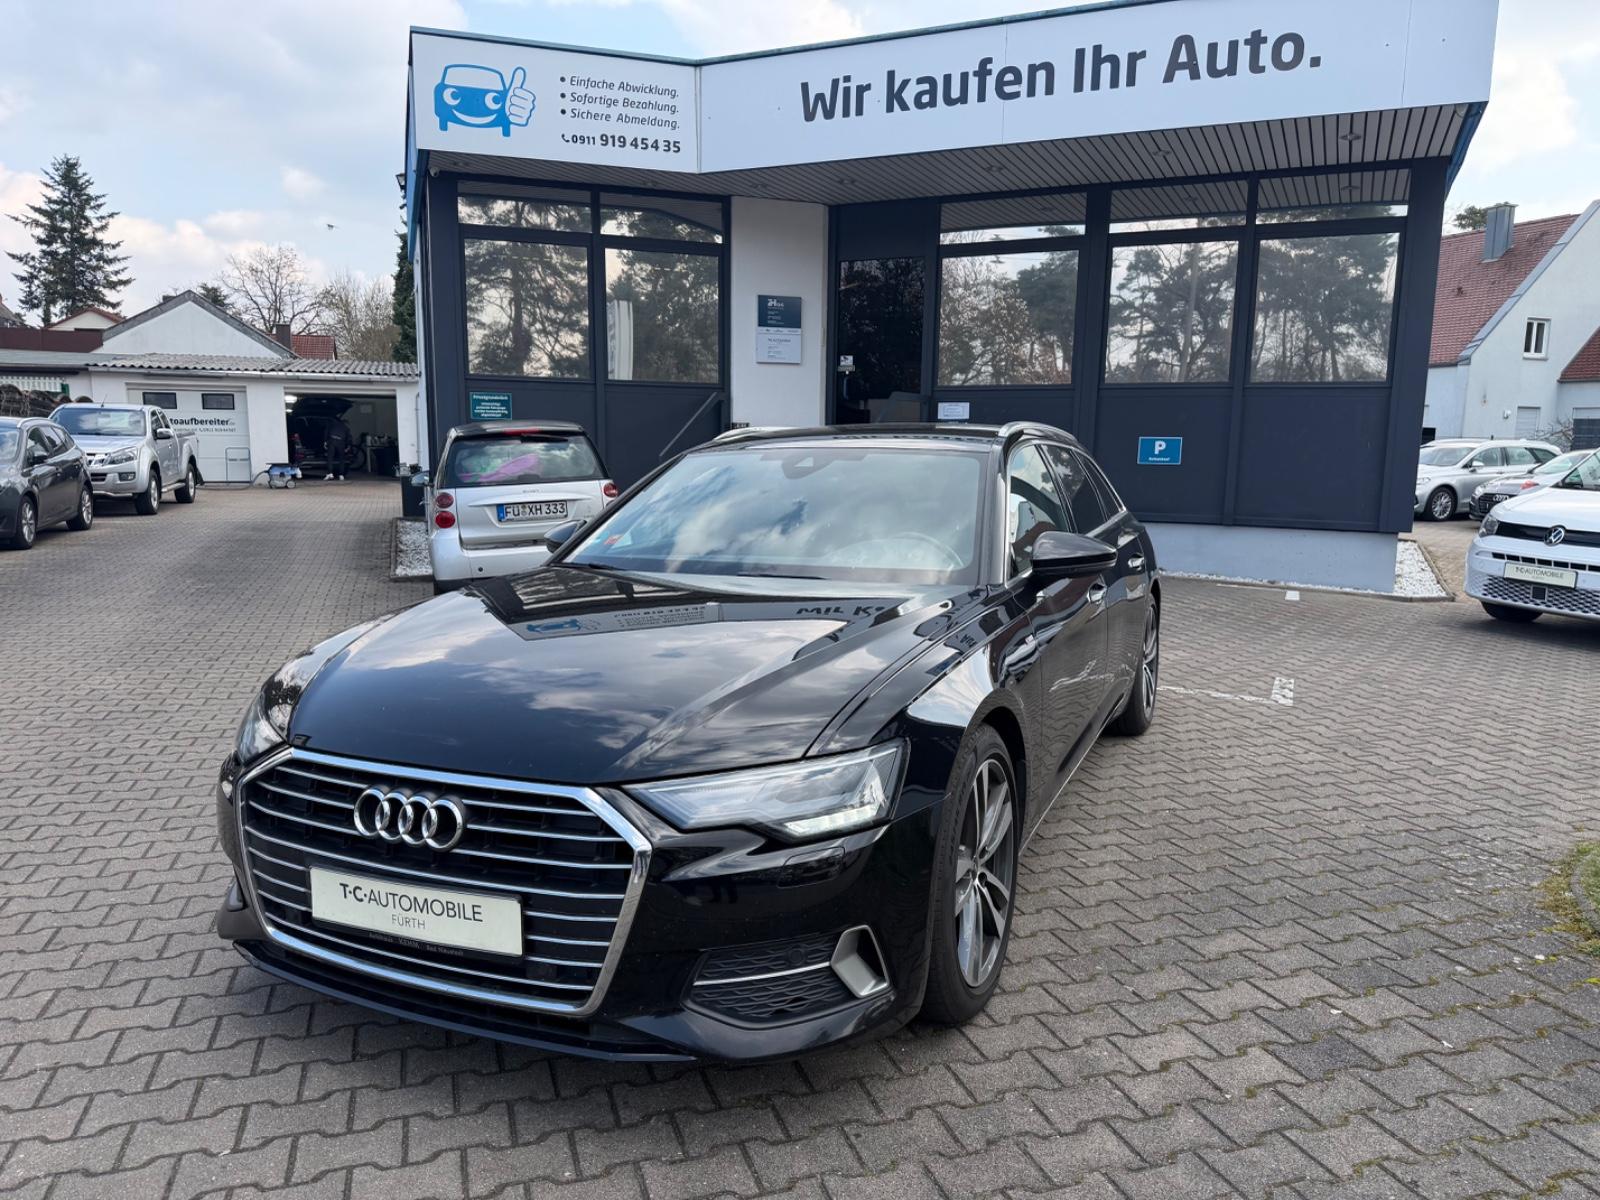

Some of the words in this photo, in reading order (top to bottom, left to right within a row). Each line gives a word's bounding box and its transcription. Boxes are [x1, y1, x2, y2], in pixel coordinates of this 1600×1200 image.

[800, 76, 872, 122] Wir
[885, 57, 1055, 114] kaufen
[1073, 44, 1147, 93] Ihr
[1162, 29, 1322, 84] Auto.
[569, 76, 615, 91] Einfache
[618, 81, 680, 98] Abwicklung.
[570, 92, 619, 108] Sofortige
[622, 97, 680, 114] Bezahlung.
[570, 108, 612, 123] Sichere
[616, 113, 681, 130] Abmeldung.
[571, 134, 596, 146] 0911
[1154, 440, 1167, 455] P
[391, 912, 427, 930] FÜRTH
